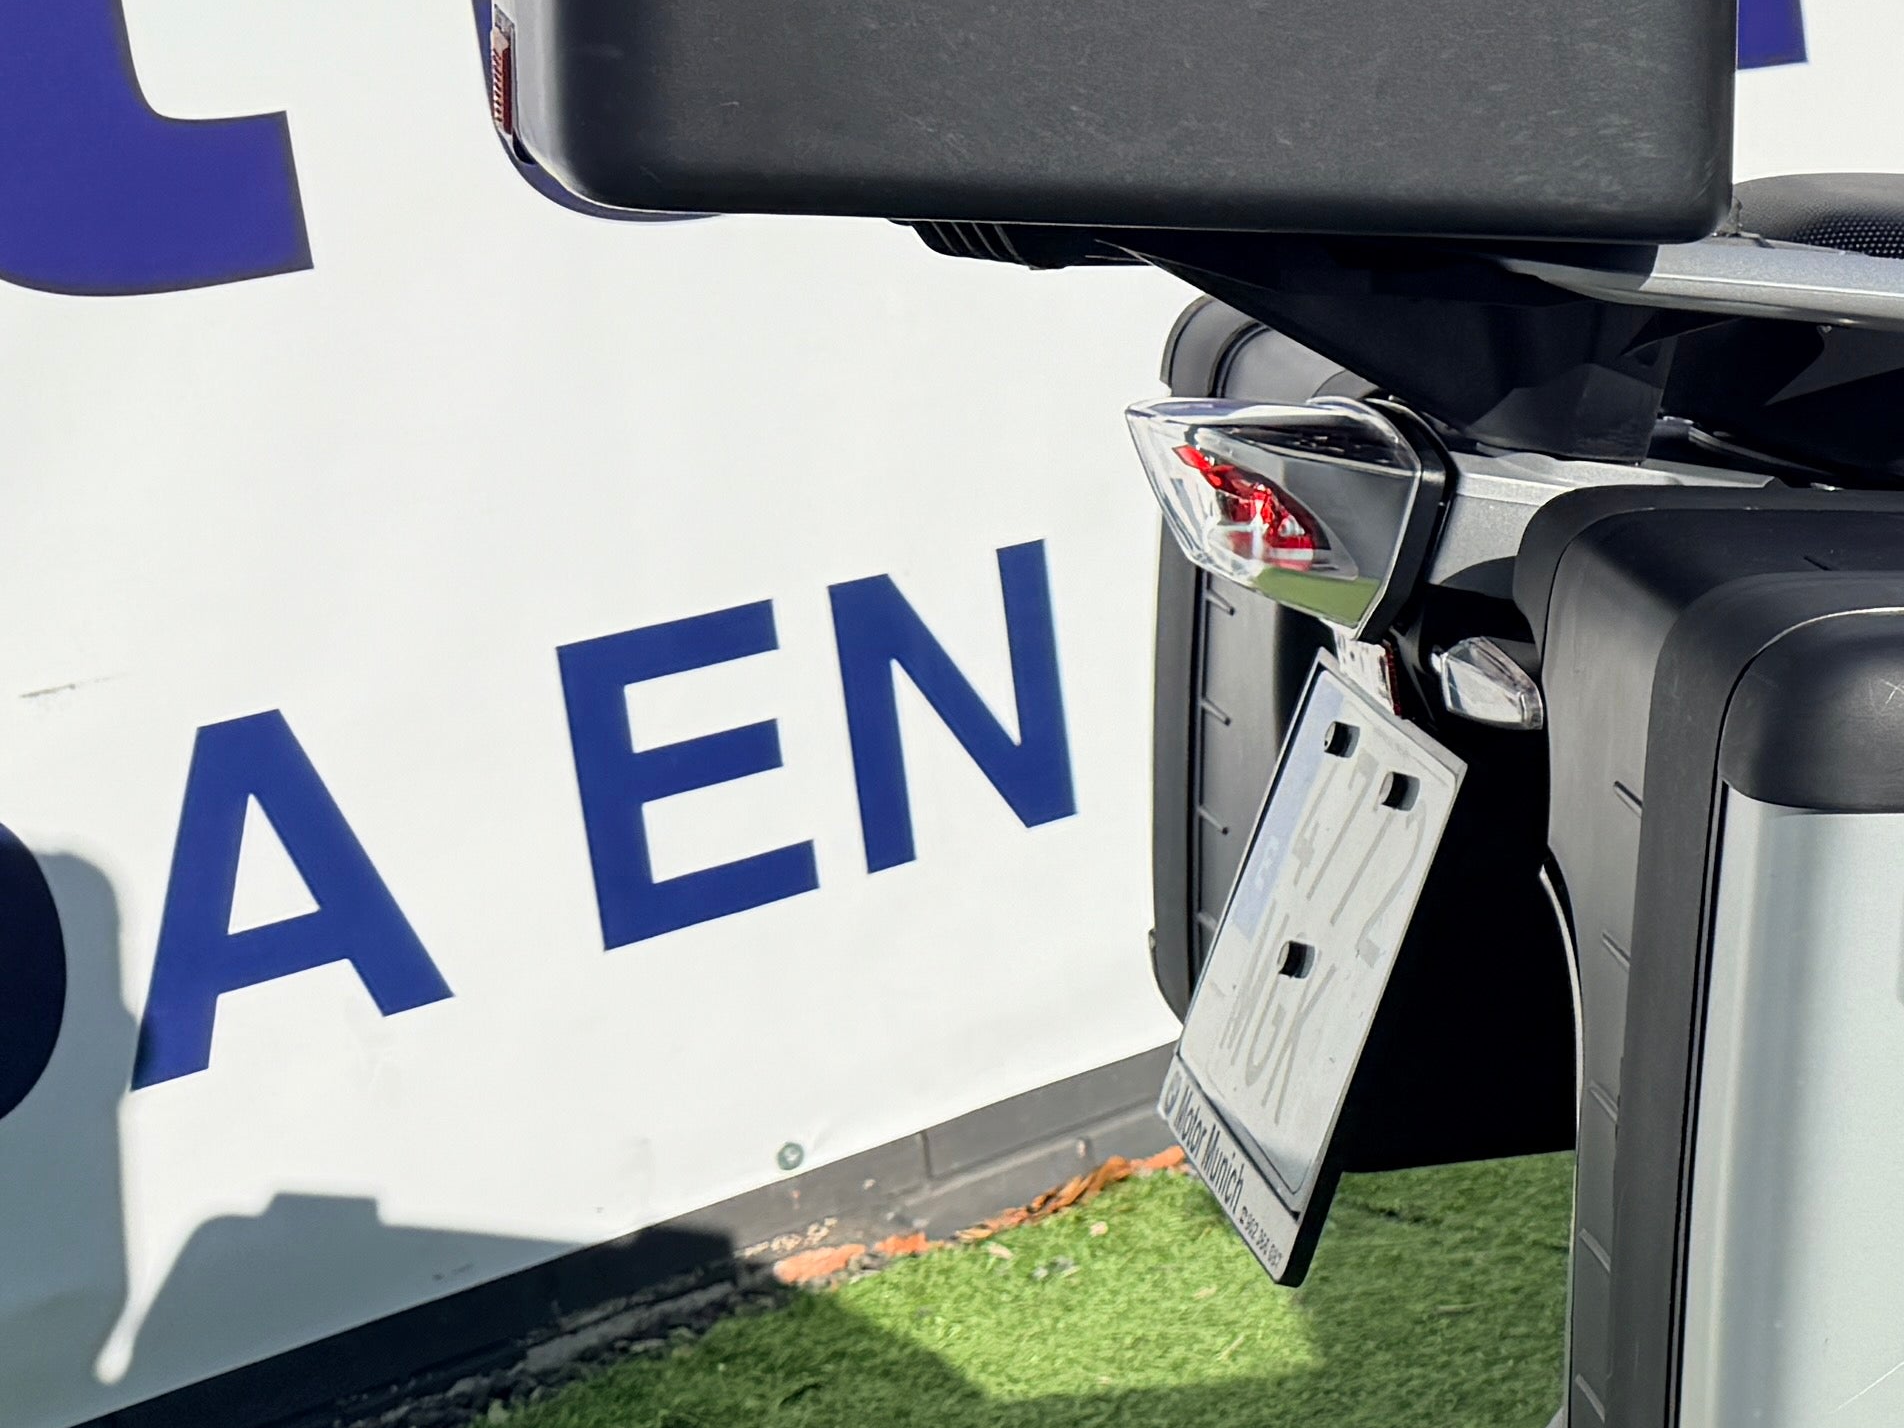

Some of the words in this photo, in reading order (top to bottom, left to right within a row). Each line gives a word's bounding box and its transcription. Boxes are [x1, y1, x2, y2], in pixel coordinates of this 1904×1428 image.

[0, 707, 455, 1120] A
[556, 539, 1077, 952] EN
[1173, 1084, 1207, 1159] Motor
[1200, 1123, 1245, 1215] Munich
